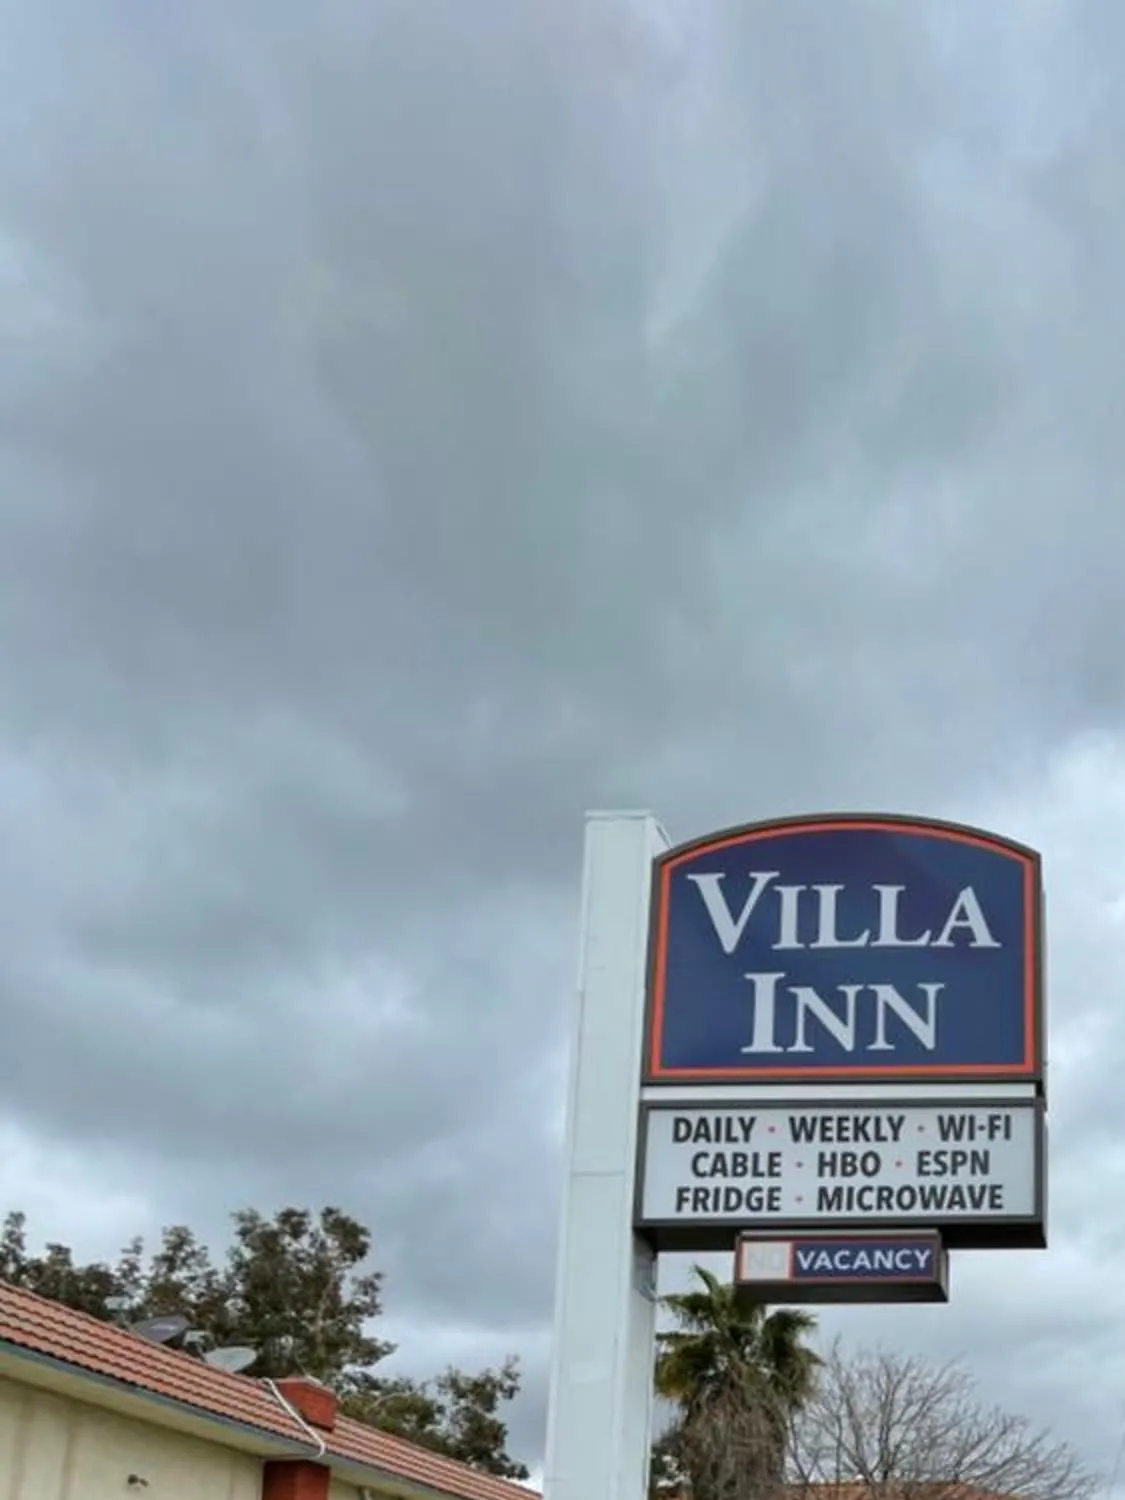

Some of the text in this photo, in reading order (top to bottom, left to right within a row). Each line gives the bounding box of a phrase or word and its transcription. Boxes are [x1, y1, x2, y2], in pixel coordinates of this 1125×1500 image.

[687, 870, 1002, 954] VILLA
[740, 971, 946, 1054] INN
[672, 1114, 1013, 1144] DAILY WEEKLY WI-FI
[690, 1150, 990, 1178] CABLE HBO ESPN
[674, 1184, 1004, 1213] FRIDGE MICROWAVE
[797, 1248, 931, 1270] VACANCY
